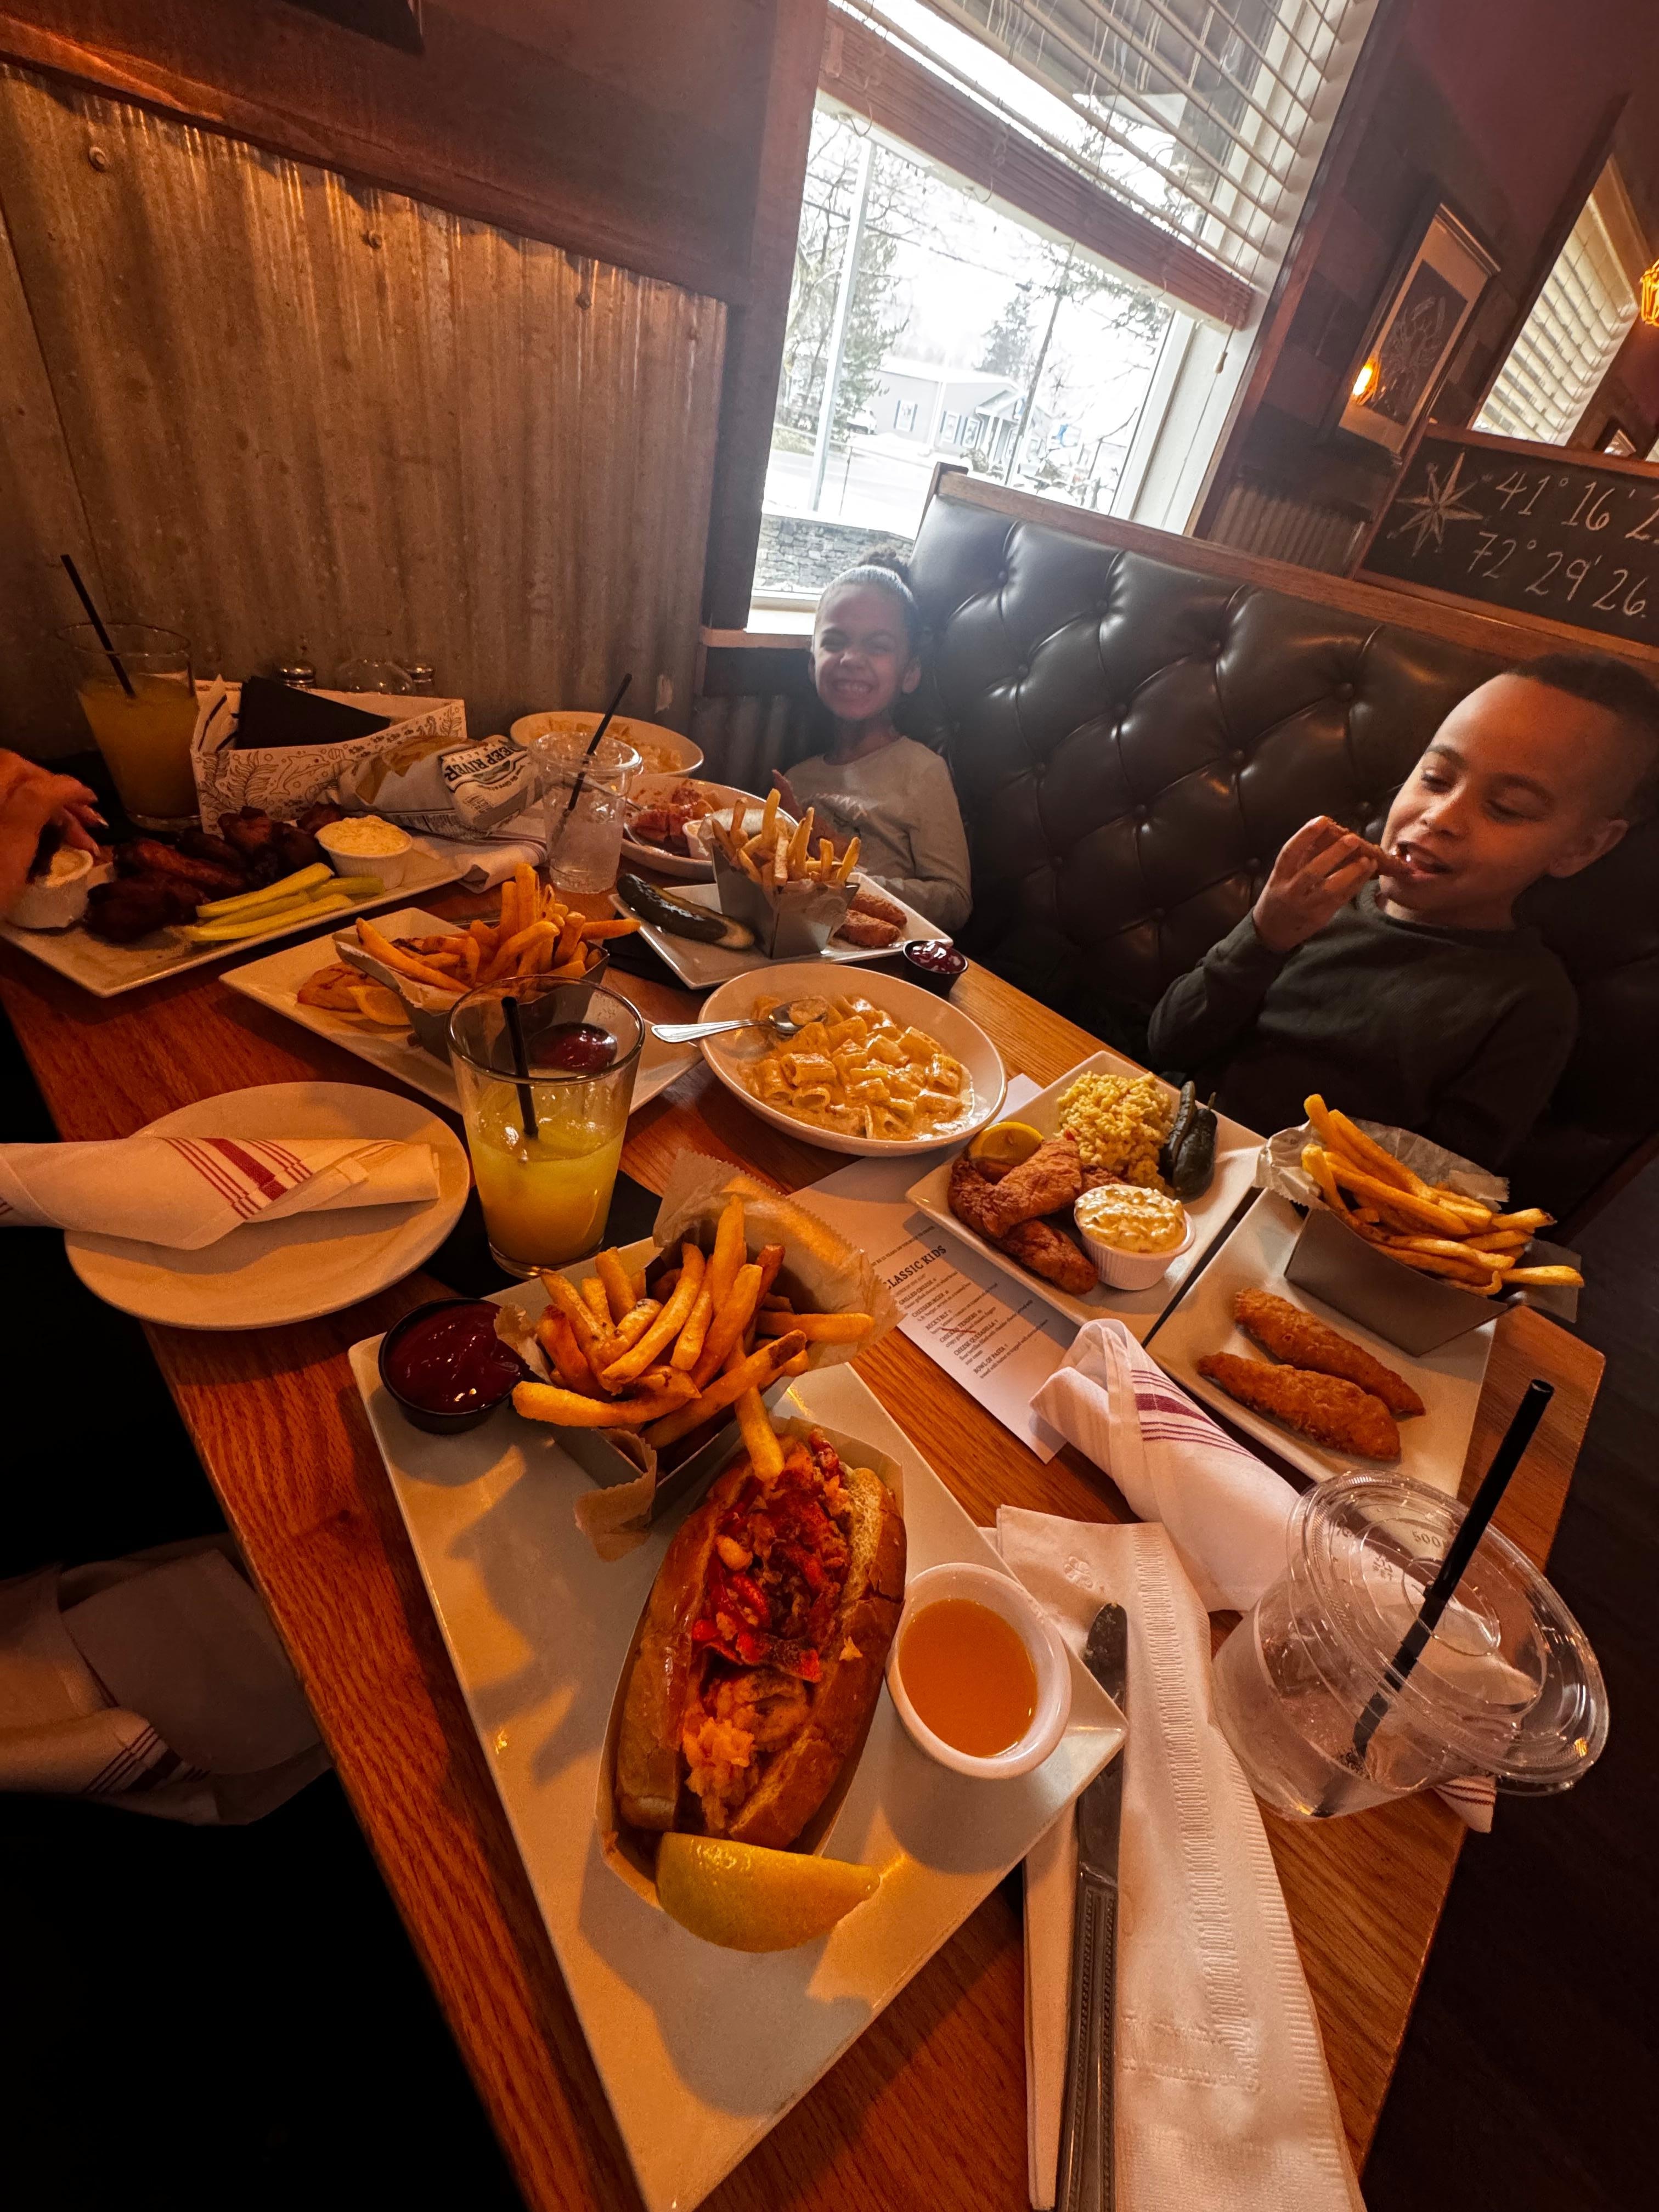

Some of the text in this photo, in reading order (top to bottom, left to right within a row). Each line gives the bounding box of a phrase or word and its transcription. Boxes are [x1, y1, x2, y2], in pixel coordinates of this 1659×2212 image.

[444, 758, 489, 782] RIVER
[922, 1245, 946, 1265] KIDS
[973, 1361, 988, 1374] BOWL
